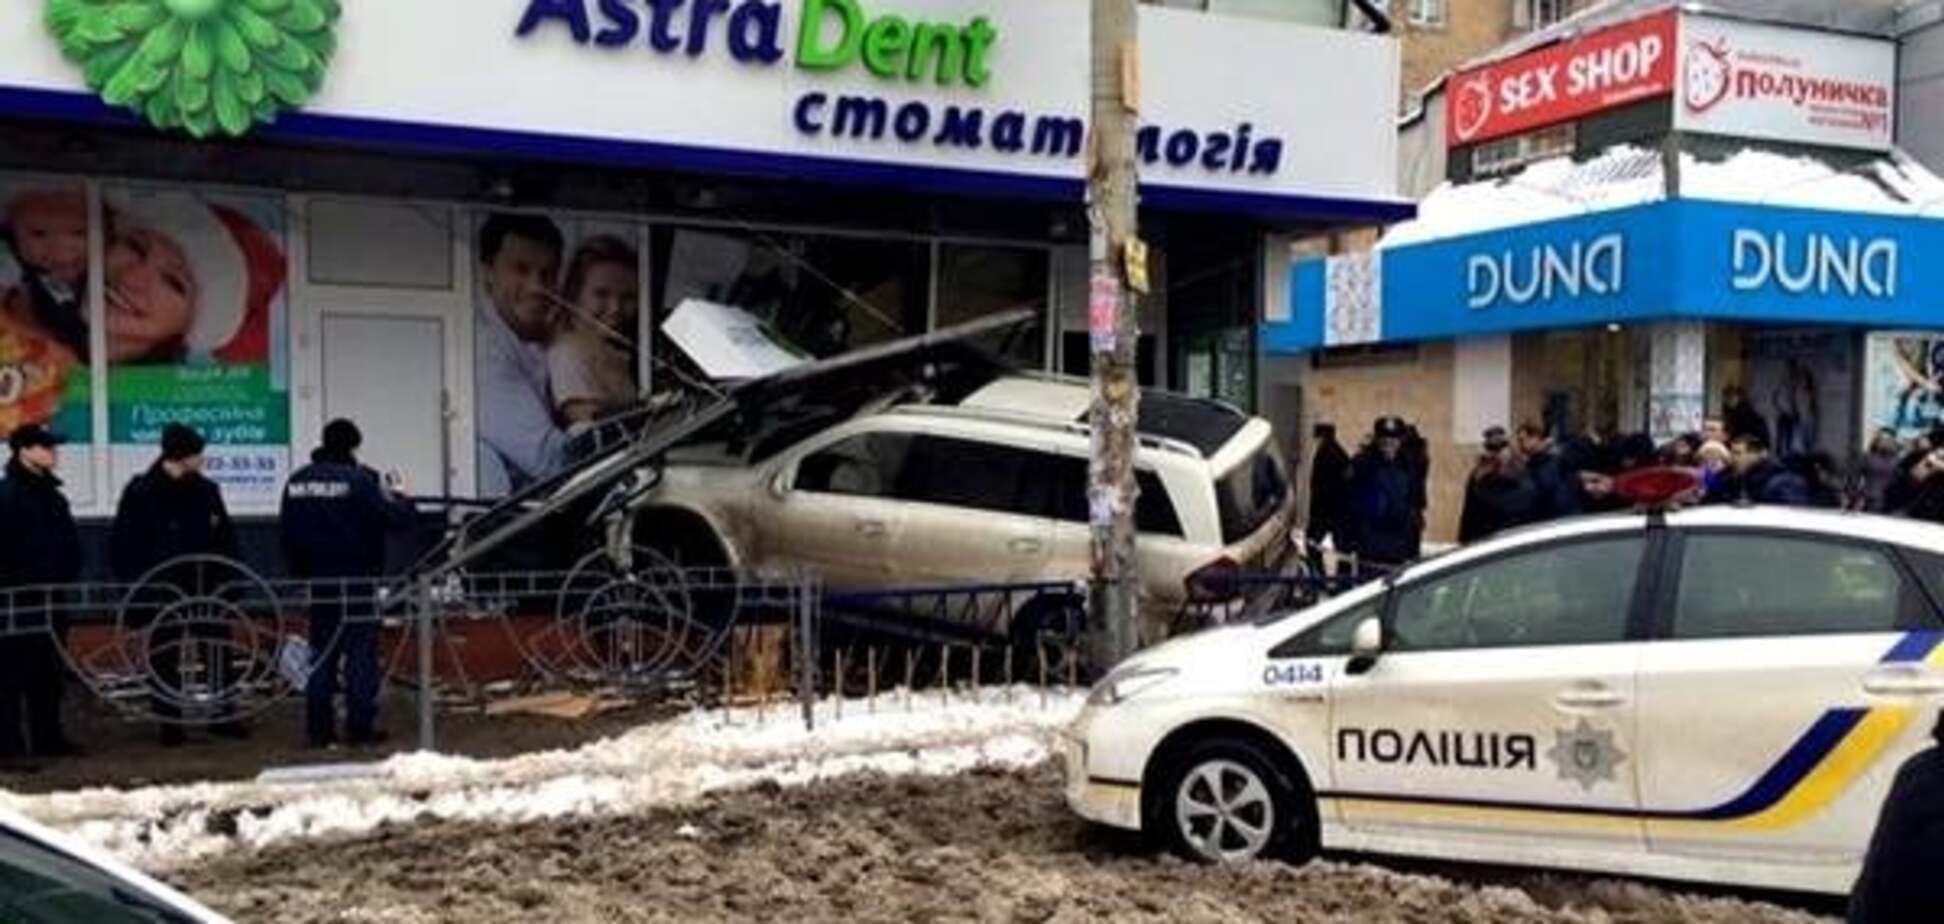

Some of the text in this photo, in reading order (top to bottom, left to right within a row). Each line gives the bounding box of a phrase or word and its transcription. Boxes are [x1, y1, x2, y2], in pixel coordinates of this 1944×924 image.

[1500, 35, 1661, 115] SEX SHOP
[793, 91, 1283, 175] стоматлогія
[1467, 233, 1623, 309] DUNA
[1733, 229, 1898, 297] DUNA
[1337, 728, 1536, 770] ПОЛІЦІЯ
